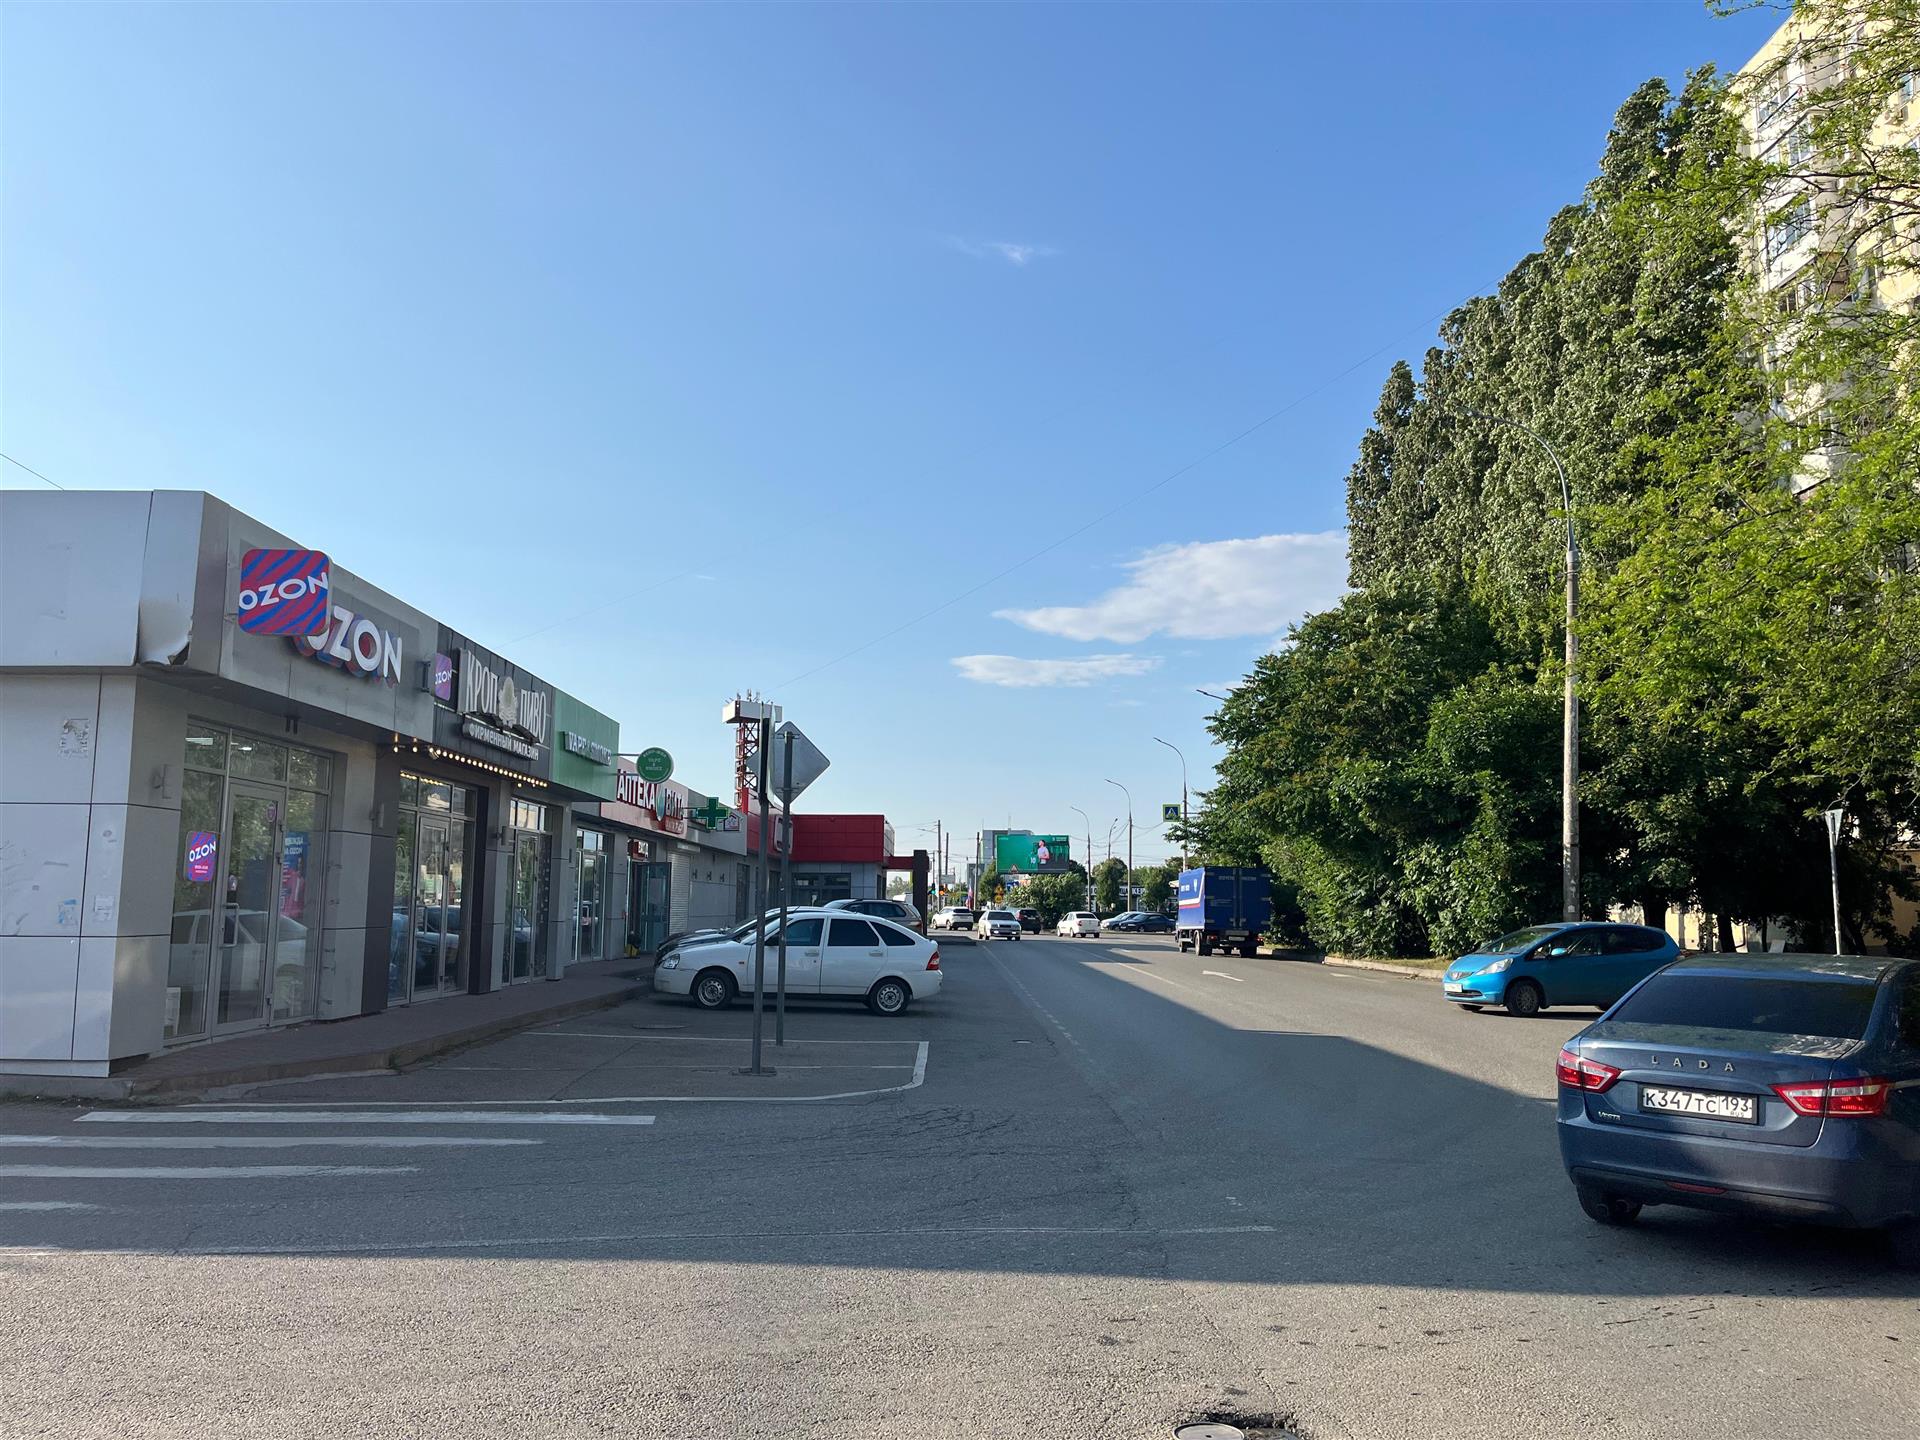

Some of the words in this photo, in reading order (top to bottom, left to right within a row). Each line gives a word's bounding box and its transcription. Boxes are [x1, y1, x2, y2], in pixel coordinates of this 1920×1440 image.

[239, 572, 328, 610] OZON
[466, 650, 498, 715] КРОП
[520, 689, 546, 743] ПИВО
[469, 723, 512, 751] ФИРМЕННЫЙ
[513, 739, 539, 760] МАГАЗИН
[617, 774, 657, 810] АПТЕКА
[189, 841, 217, 862] OZON
[1652, 1055, 1735, 1073] LADA
[1645, 1091, 1717, 1113] К347ТС
[1721, 1098, 1750, 1112] 193
